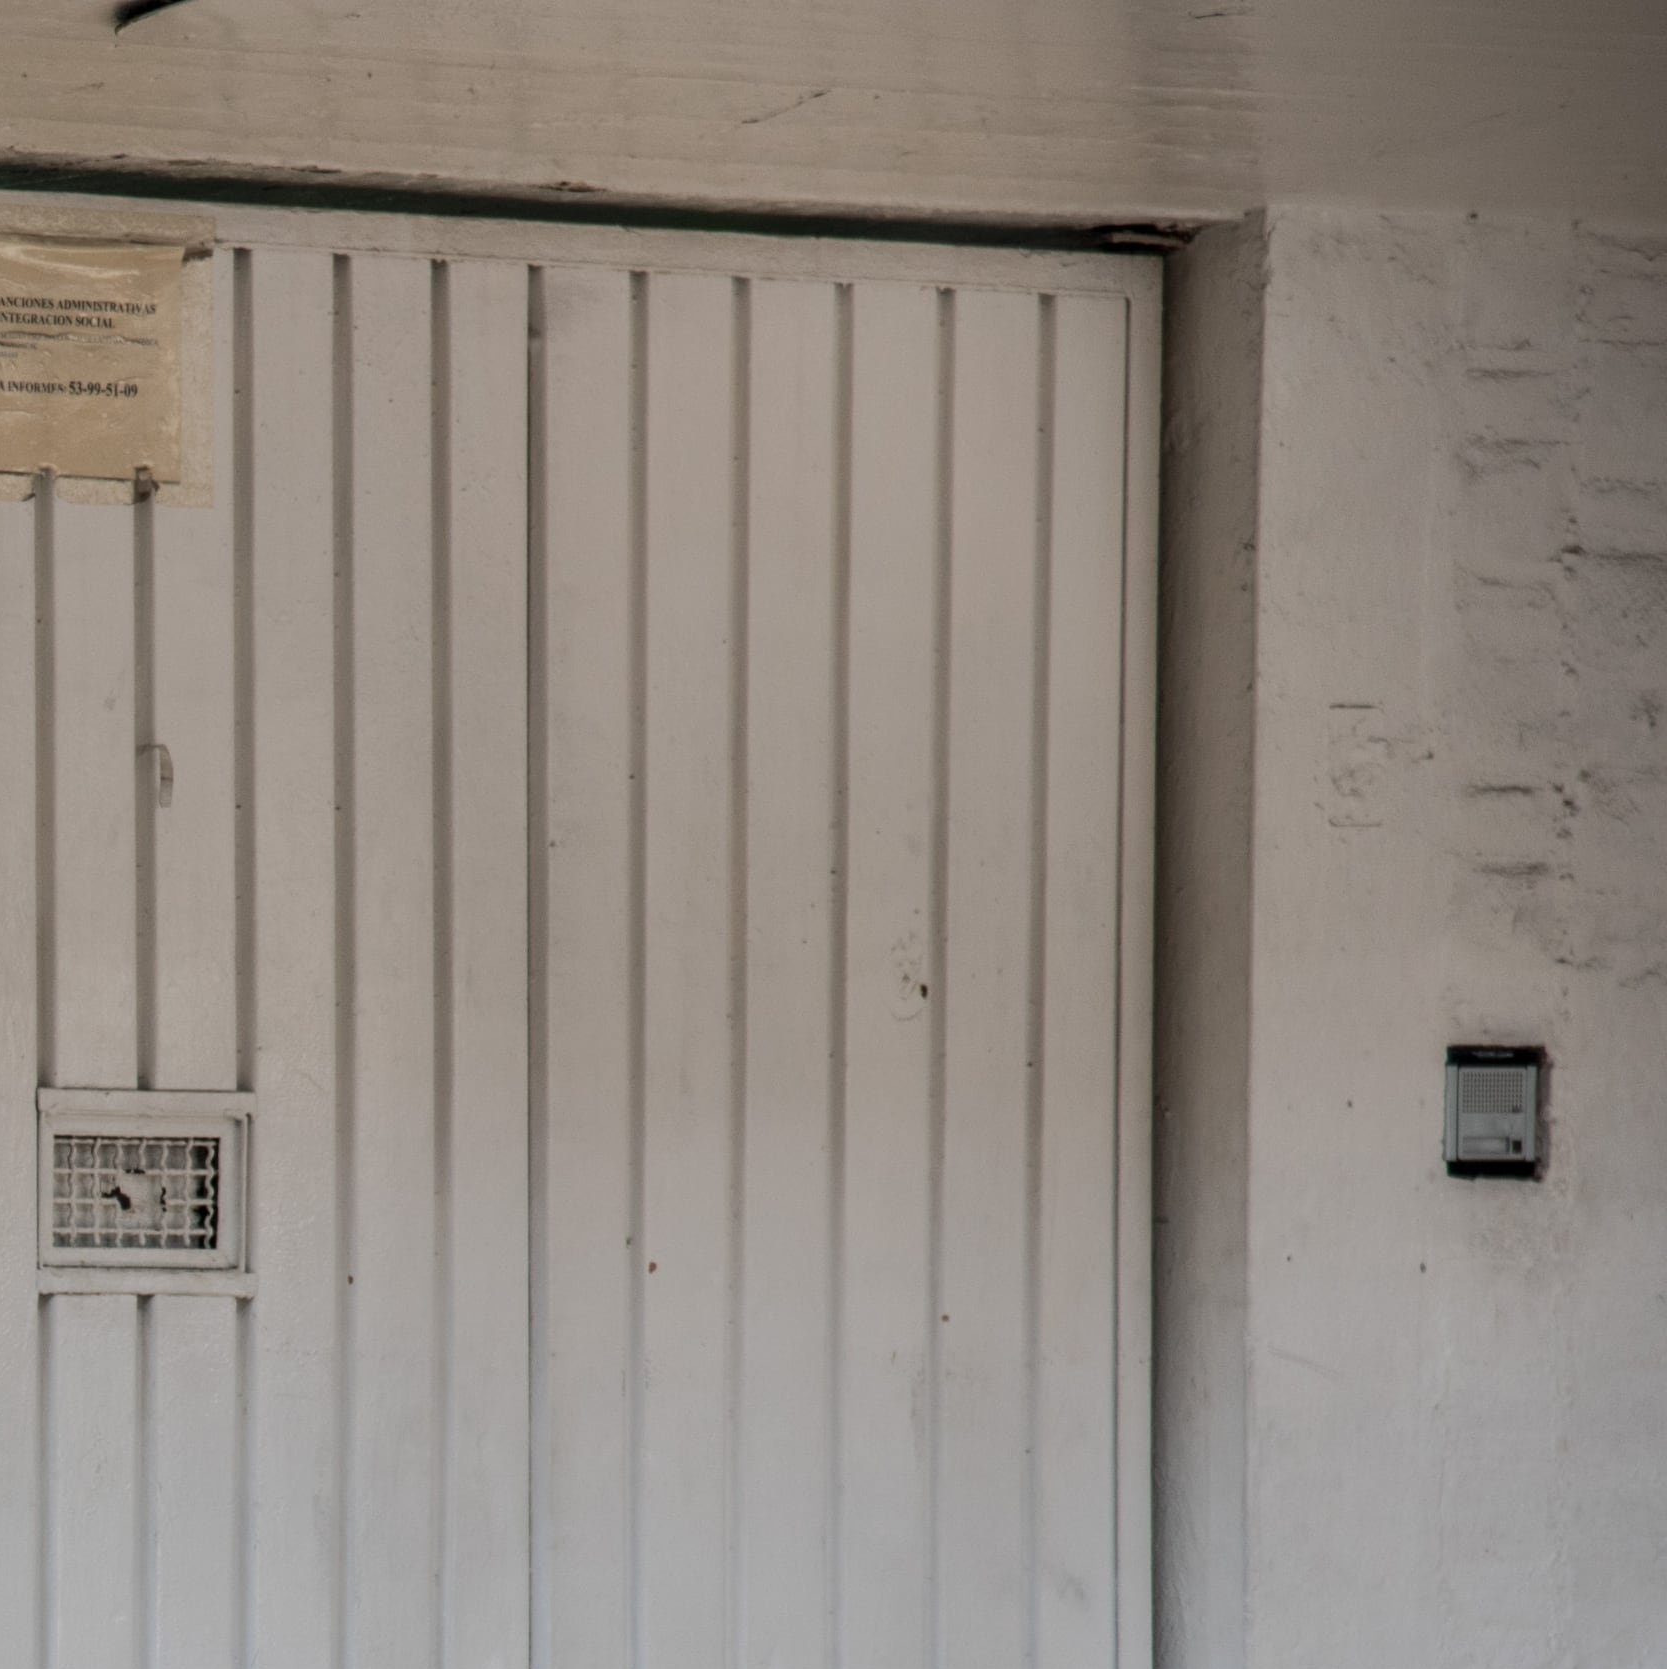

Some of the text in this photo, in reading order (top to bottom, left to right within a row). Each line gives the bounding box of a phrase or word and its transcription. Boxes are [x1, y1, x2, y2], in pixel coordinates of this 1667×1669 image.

[56, 298, 156, 315] ADMINISTRATIVAS
[75, 316, 115, 329] SOCIAL
[69, 380, 138, 398] 53-99-51-09
